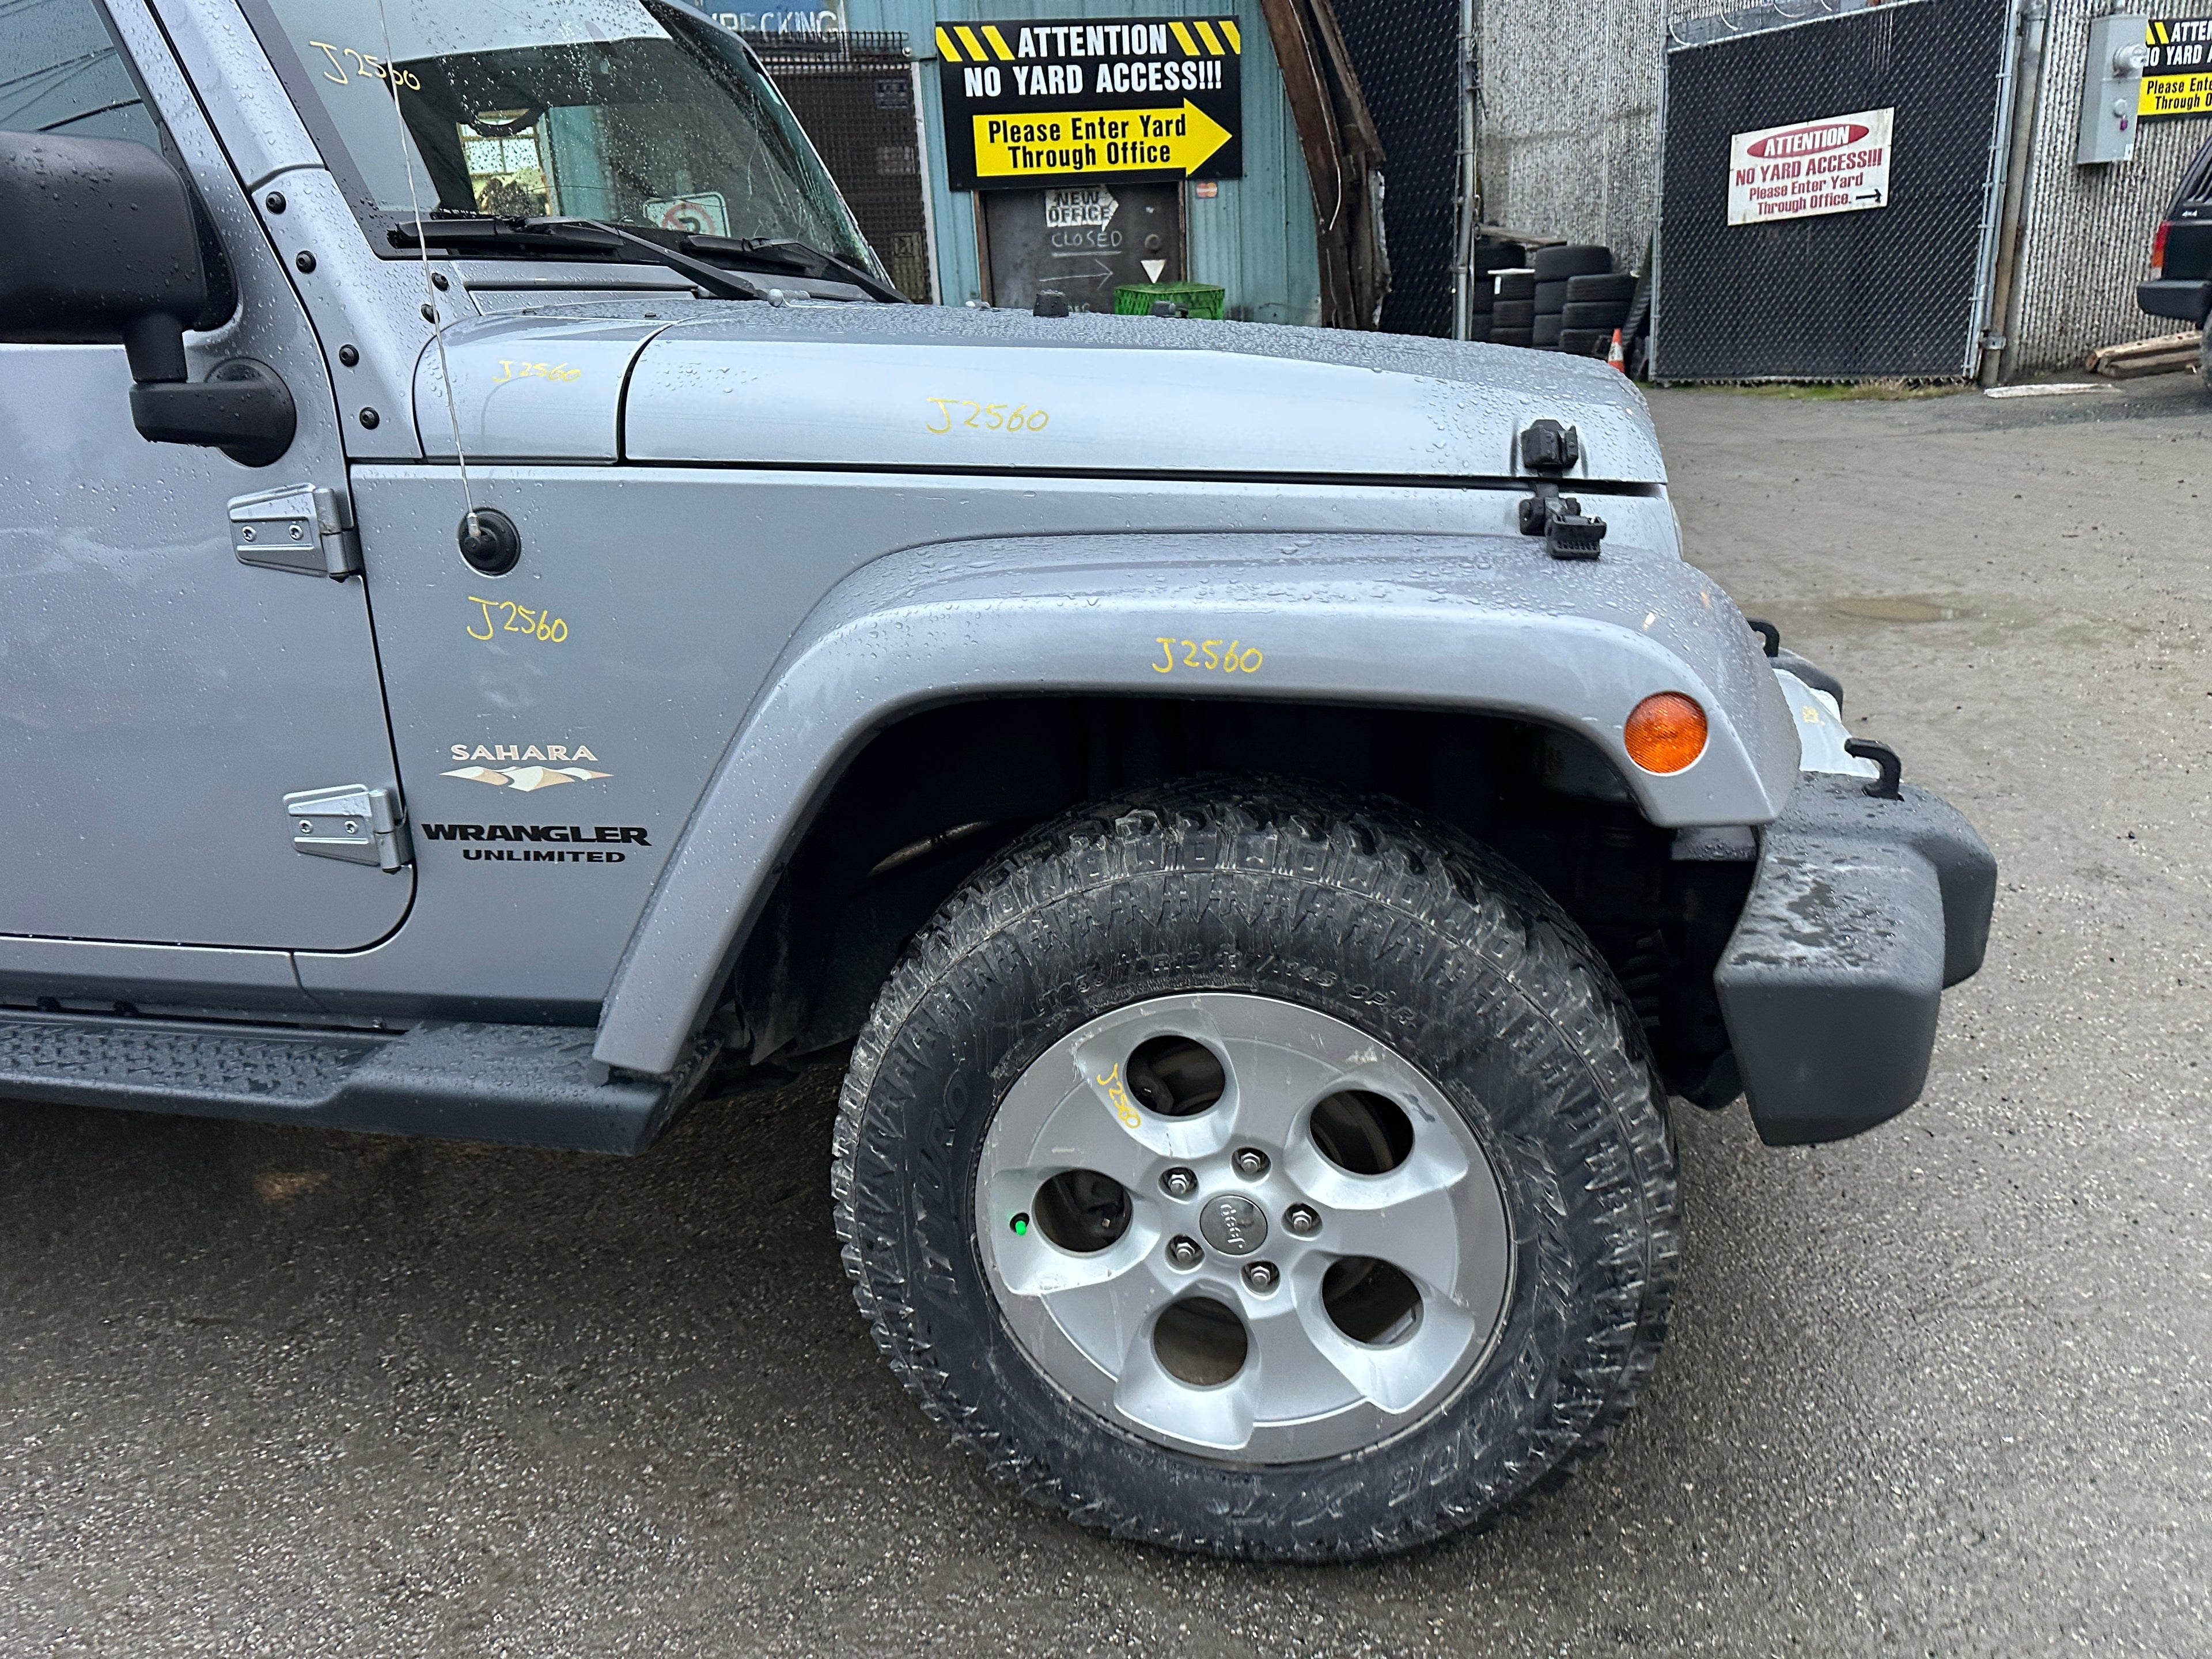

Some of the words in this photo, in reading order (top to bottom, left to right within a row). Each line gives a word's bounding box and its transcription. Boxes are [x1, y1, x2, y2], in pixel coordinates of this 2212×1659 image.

[712, 11, 839, 43] RECKING
[1018, 24, 1168, 58] ATTENTION
[309, 41, 421, 90] J2560
[2166, 44, 2202, 66] YARD
[964, 66, 1002, 97] NO
[1013, 65, 1083, 95] YARD
[1096, 60, 1222, 93] ACCESS!!!
[2147, 79, 2184, 95] Please
[2155, 93, 2200, 111] Through
[988, 120, 1060, 143] Please
[1071, 117, 1129, 140] Enter
[1140, 113, 1186, 138] Yard
[1764, 126, 1850, 156] ATTENTION
[1007, 145, 1096, 170] Through
[1107, 142, 1170, 164] Office
[1736, 168, 1755, 187] NO
[1760, 161, 1801, 182] YARD
[1805, 148, 1883, 176] ACCESS!!!
[1056, 191, 1099, 206] NEW
[1749, 185, 1787, 201] Please
[1791, 180, 1826, 195] Enter
[1831, 173, 1863, 190] Yard
[1048, 206, 1111, 224] OFFICE
[1758, 197, 1806, 215] Through
[1051, 230, 1122, 247] CLOSED
[493, 360, 581, 382] J2560
[926, 397, 1050, 433] J2560
[467, 596, 568, 642] J2560
[1152, 637, 1263, 673] J2560
[450, 744, 598, 760] SAHARA
[421, 824, 653, 846] WRANGLER
[463, 849, 626, 863] UNLIMITED
[1220, 1204, 1246, 1249] Jeep
